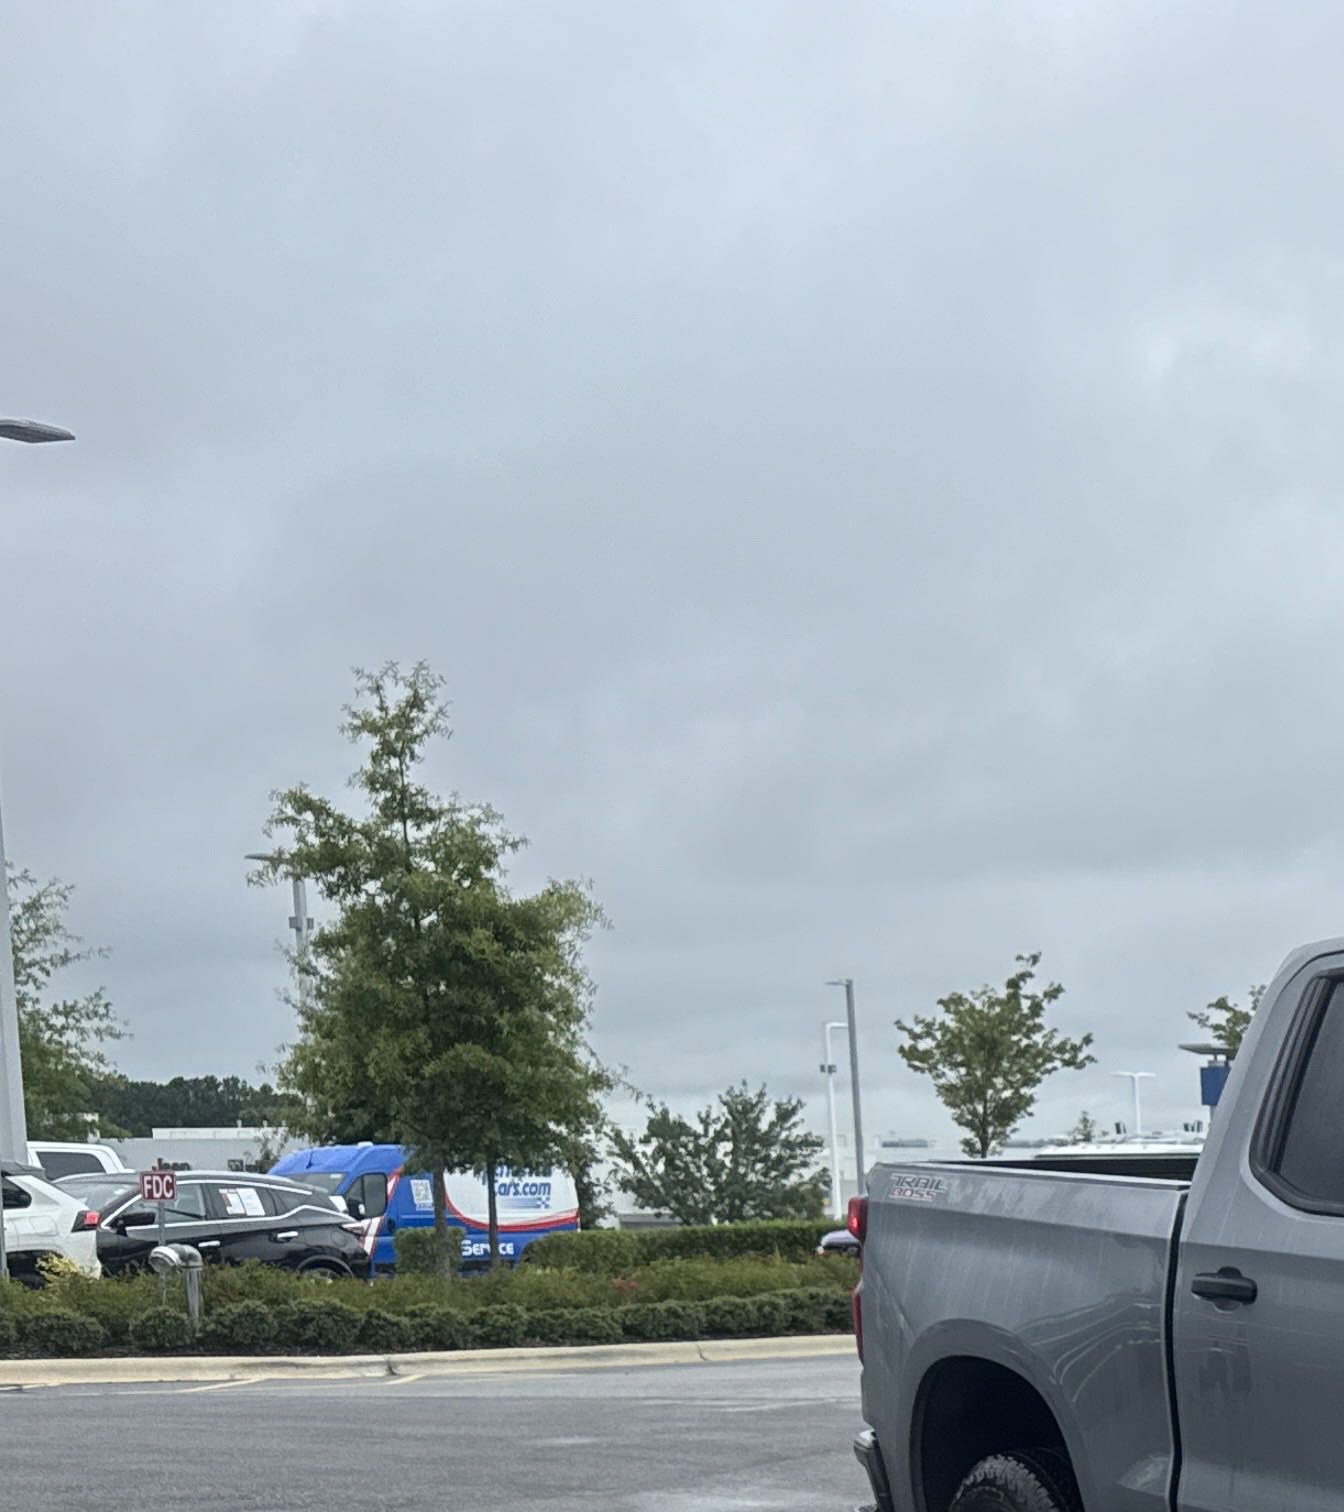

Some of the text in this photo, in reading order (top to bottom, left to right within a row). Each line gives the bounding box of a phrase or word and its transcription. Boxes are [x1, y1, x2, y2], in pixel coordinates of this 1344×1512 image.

[143, 1175, 173, 1199] FDC
[494, 1179, 551, 1196] ars.com
[890, 1172, 947, 1192] TRAIL
